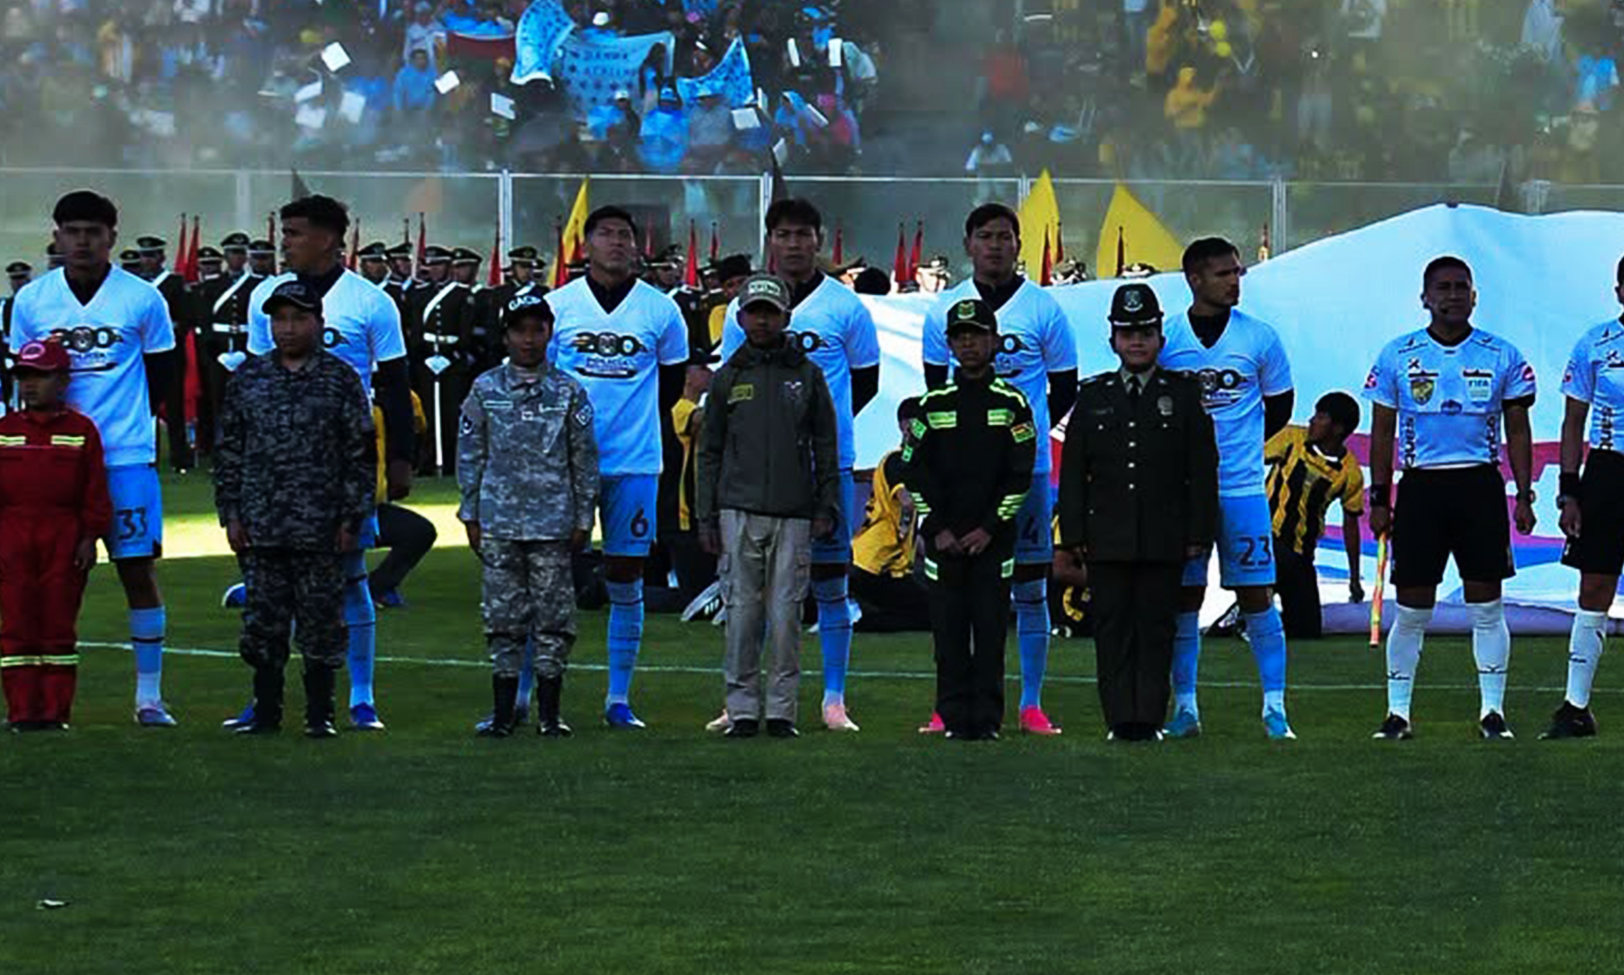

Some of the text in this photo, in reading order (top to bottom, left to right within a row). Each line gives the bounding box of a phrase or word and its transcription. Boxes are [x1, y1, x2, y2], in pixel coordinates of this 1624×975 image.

[630, 507, 649, 539] 6
[1020, 516, 1039, 545] 4
[1238, 535, 1272, 566] 23
